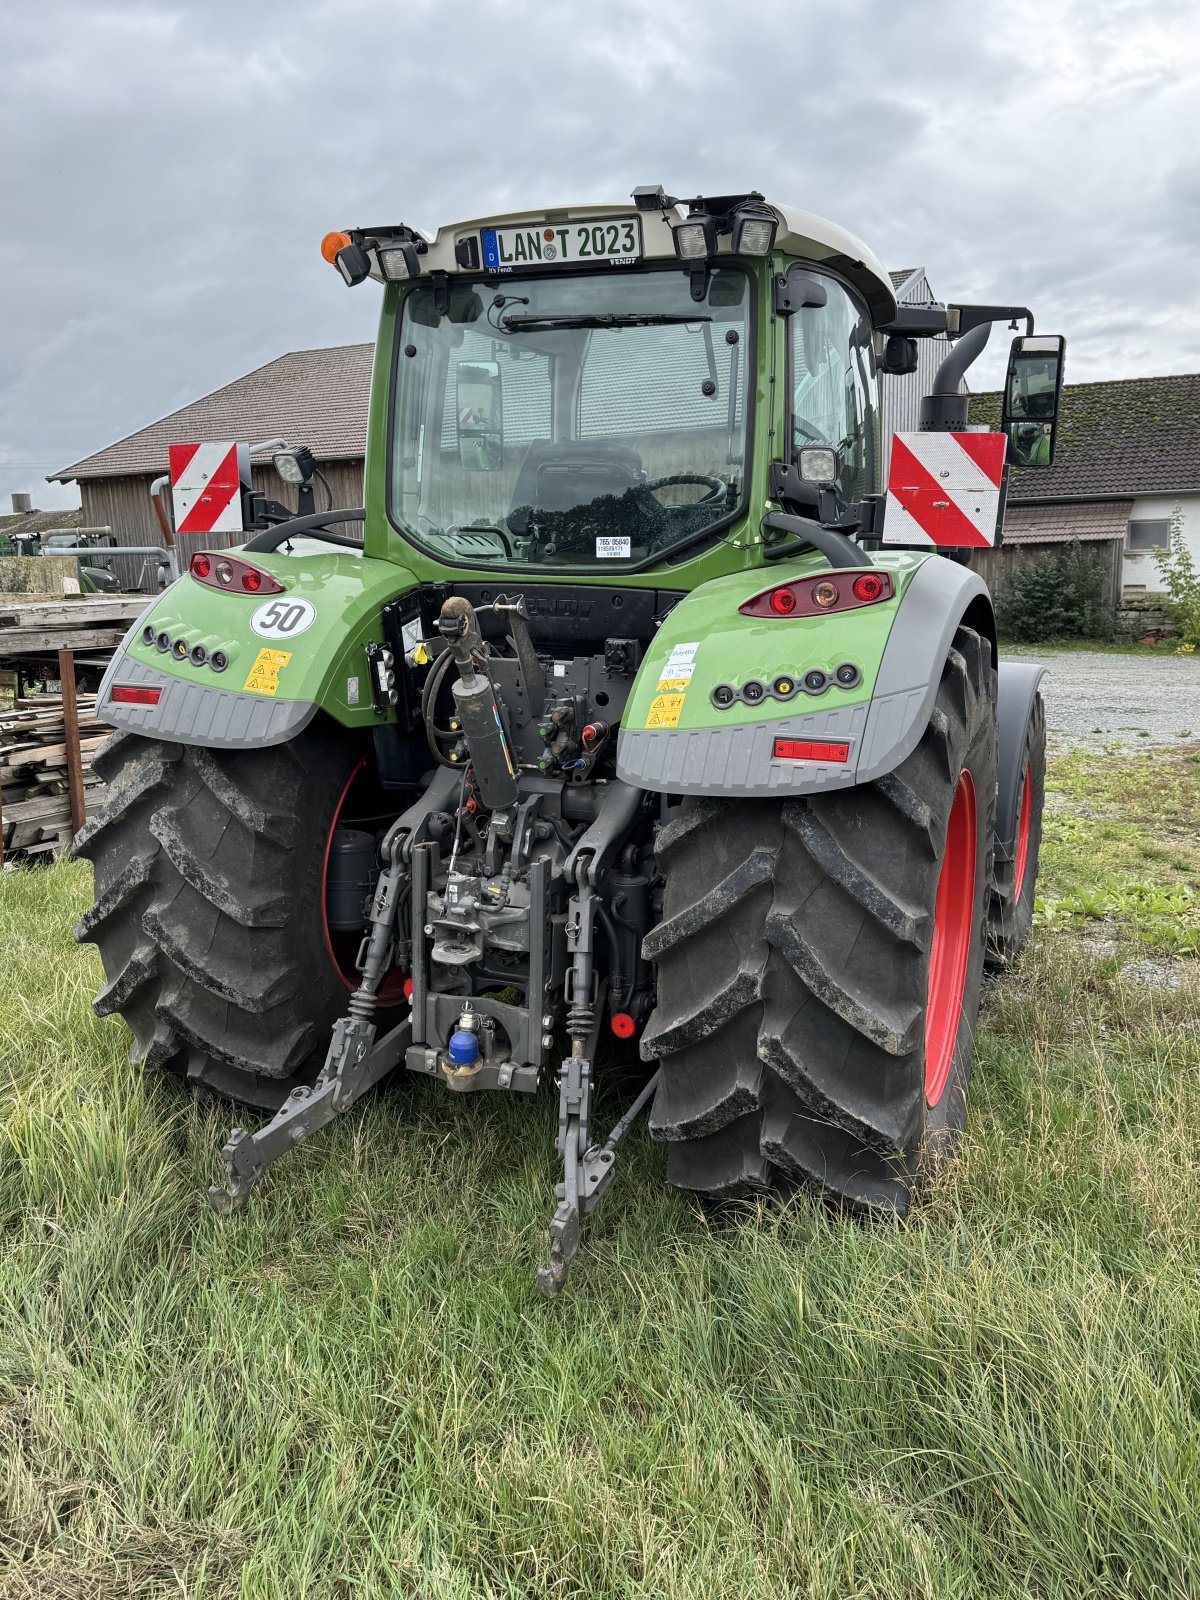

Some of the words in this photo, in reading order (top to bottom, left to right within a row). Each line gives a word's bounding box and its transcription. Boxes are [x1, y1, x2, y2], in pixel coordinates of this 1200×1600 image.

[498, 232, 542, 262] LAN
[556, 229, 569, 258] T
[578, 223, 635, 257] 2023
[488, 252, 495, 262] D
[610, 258, 637, 266] FENDT
[260, 602, 306, 632] 50
